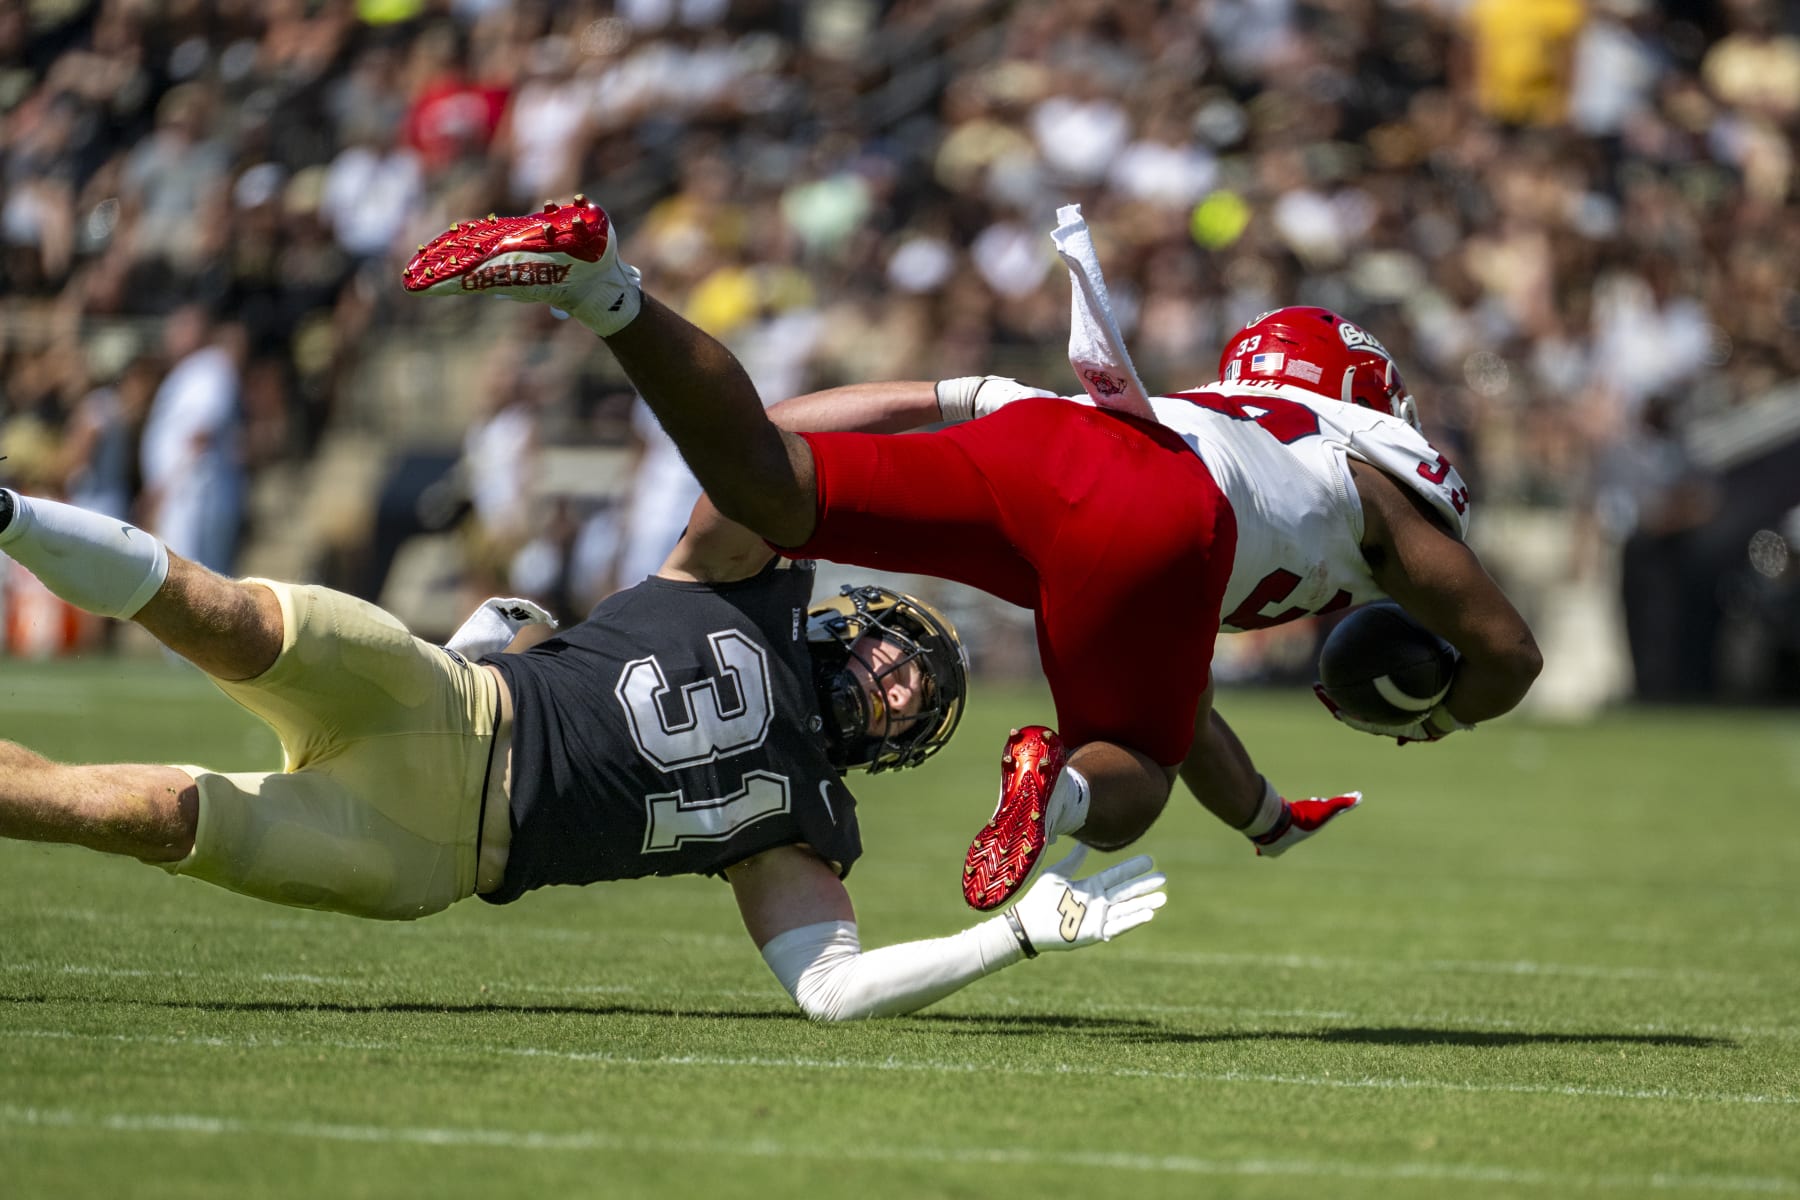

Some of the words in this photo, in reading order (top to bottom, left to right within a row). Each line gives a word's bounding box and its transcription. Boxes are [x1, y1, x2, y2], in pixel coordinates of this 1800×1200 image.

[1236, 334, 1262, 357] 33
[614, 628, 791, 855] 31
[1057, 887, 1088, 943] P
